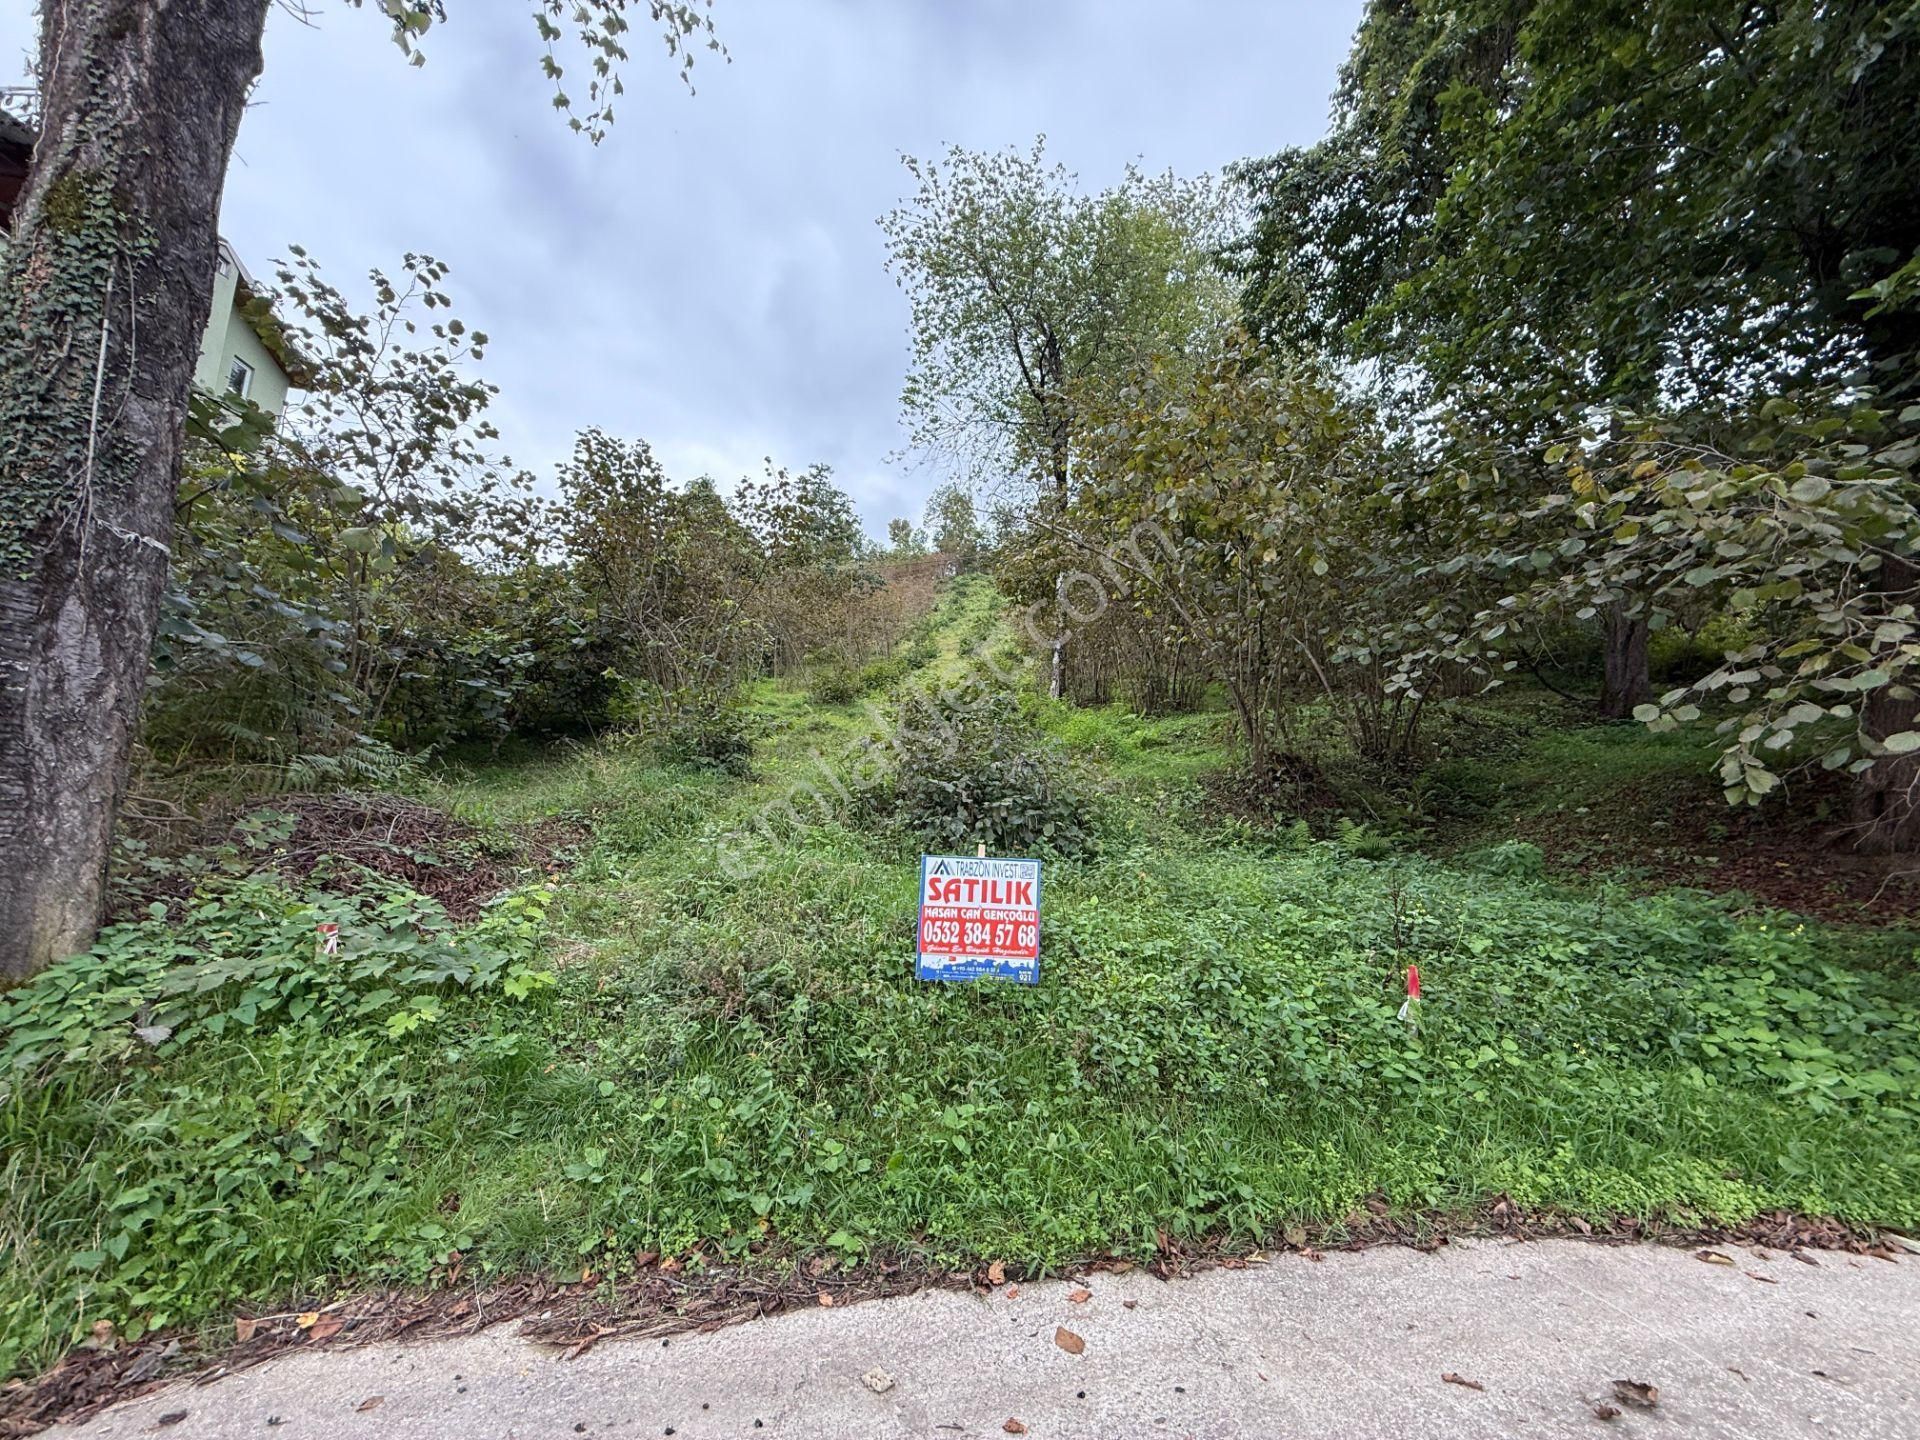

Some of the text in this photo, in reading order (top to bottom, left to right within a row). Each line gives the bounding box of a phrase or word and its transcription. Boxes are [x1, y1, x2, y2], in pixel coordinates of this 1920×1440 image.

[956, 861, 1019, 879] TRABZON INVEST
[928, 877, 1033, 906] SATILIK
[925, 907, 1035, 923] HASAN CAN GENÇOĞLU
[924, 920, 1036, 947] 0532 384 57 68
